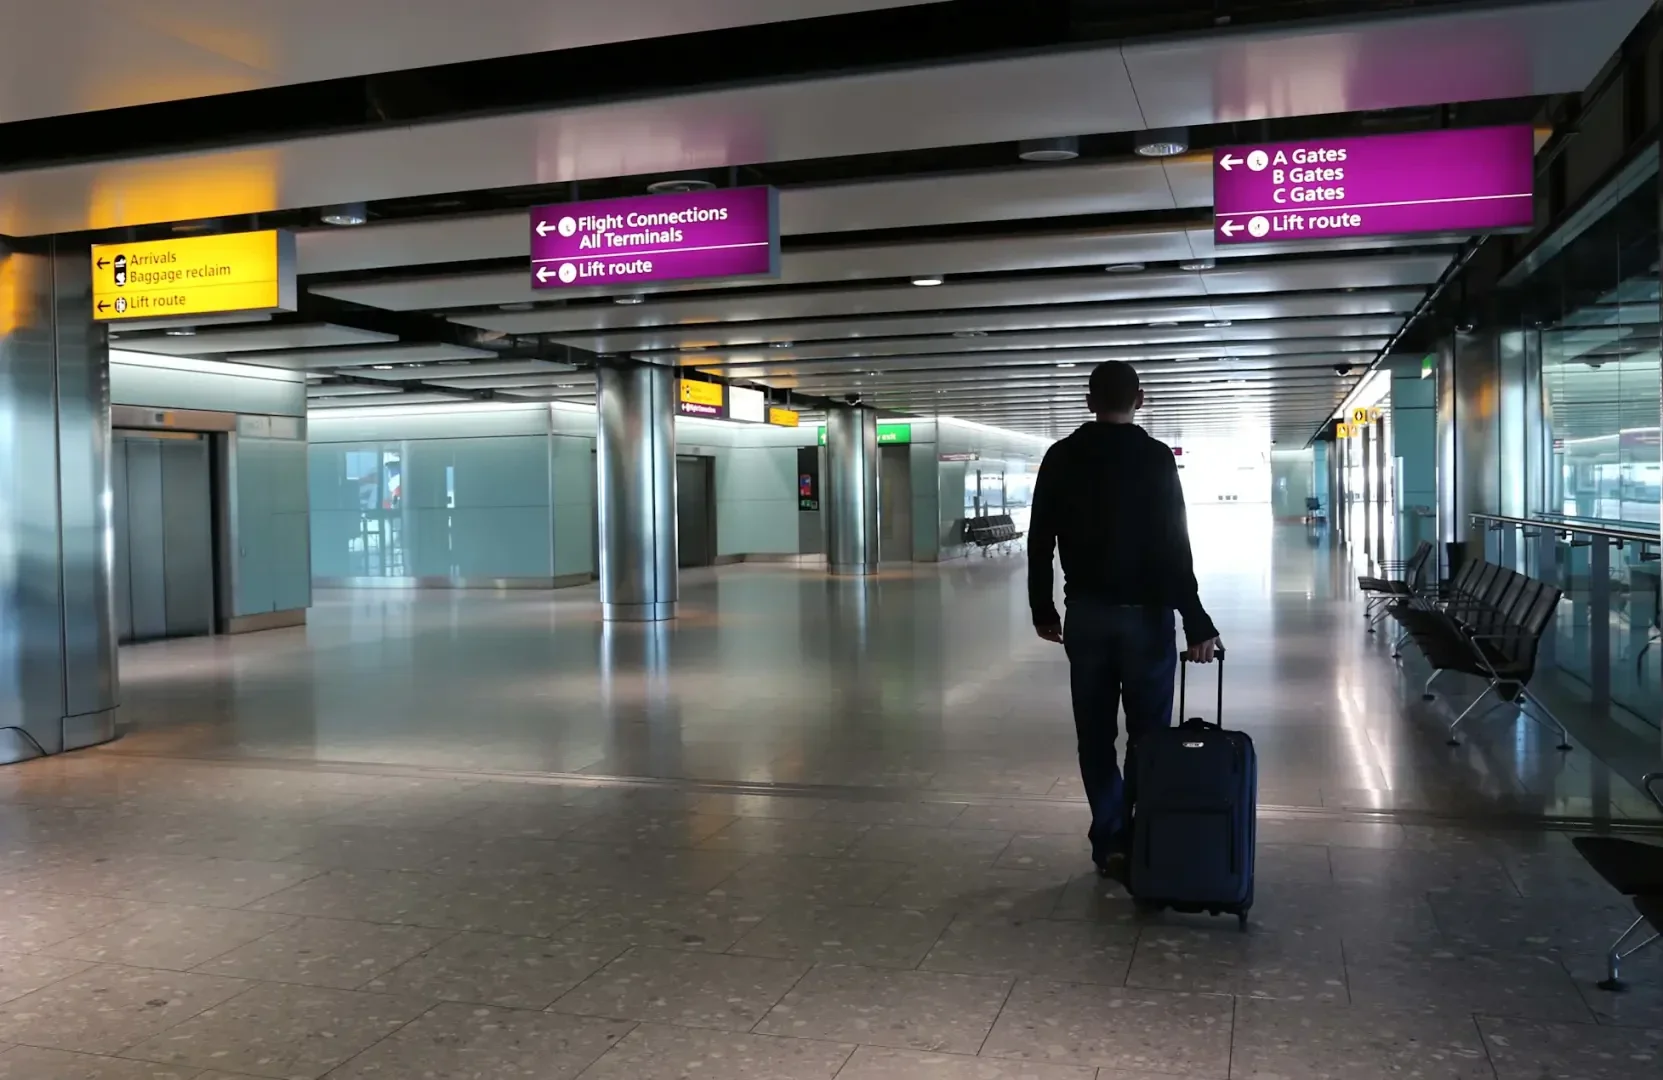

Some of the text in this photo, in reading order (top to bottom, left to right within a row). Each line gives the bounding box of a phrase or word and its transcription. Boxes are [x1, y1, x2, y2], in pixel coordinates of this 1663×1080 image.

[1272, 148, 1347, 166] A Gates
[1272, 166, 1344, 184] B Gates
[1273, 186, 1345, 203] C Gates
[578, 207, 728, 233] Flight Connections
[1273, 213, 1361, 231] Lift route
[579, 228, 683, 250] All Terminals
[130, 251, 177, 266] Arrivals
[130, 264, 231, 284] Baggage reclaim
[579, 259, 653, 278] Lift route
[130, 293, 186, 309] Lift route
